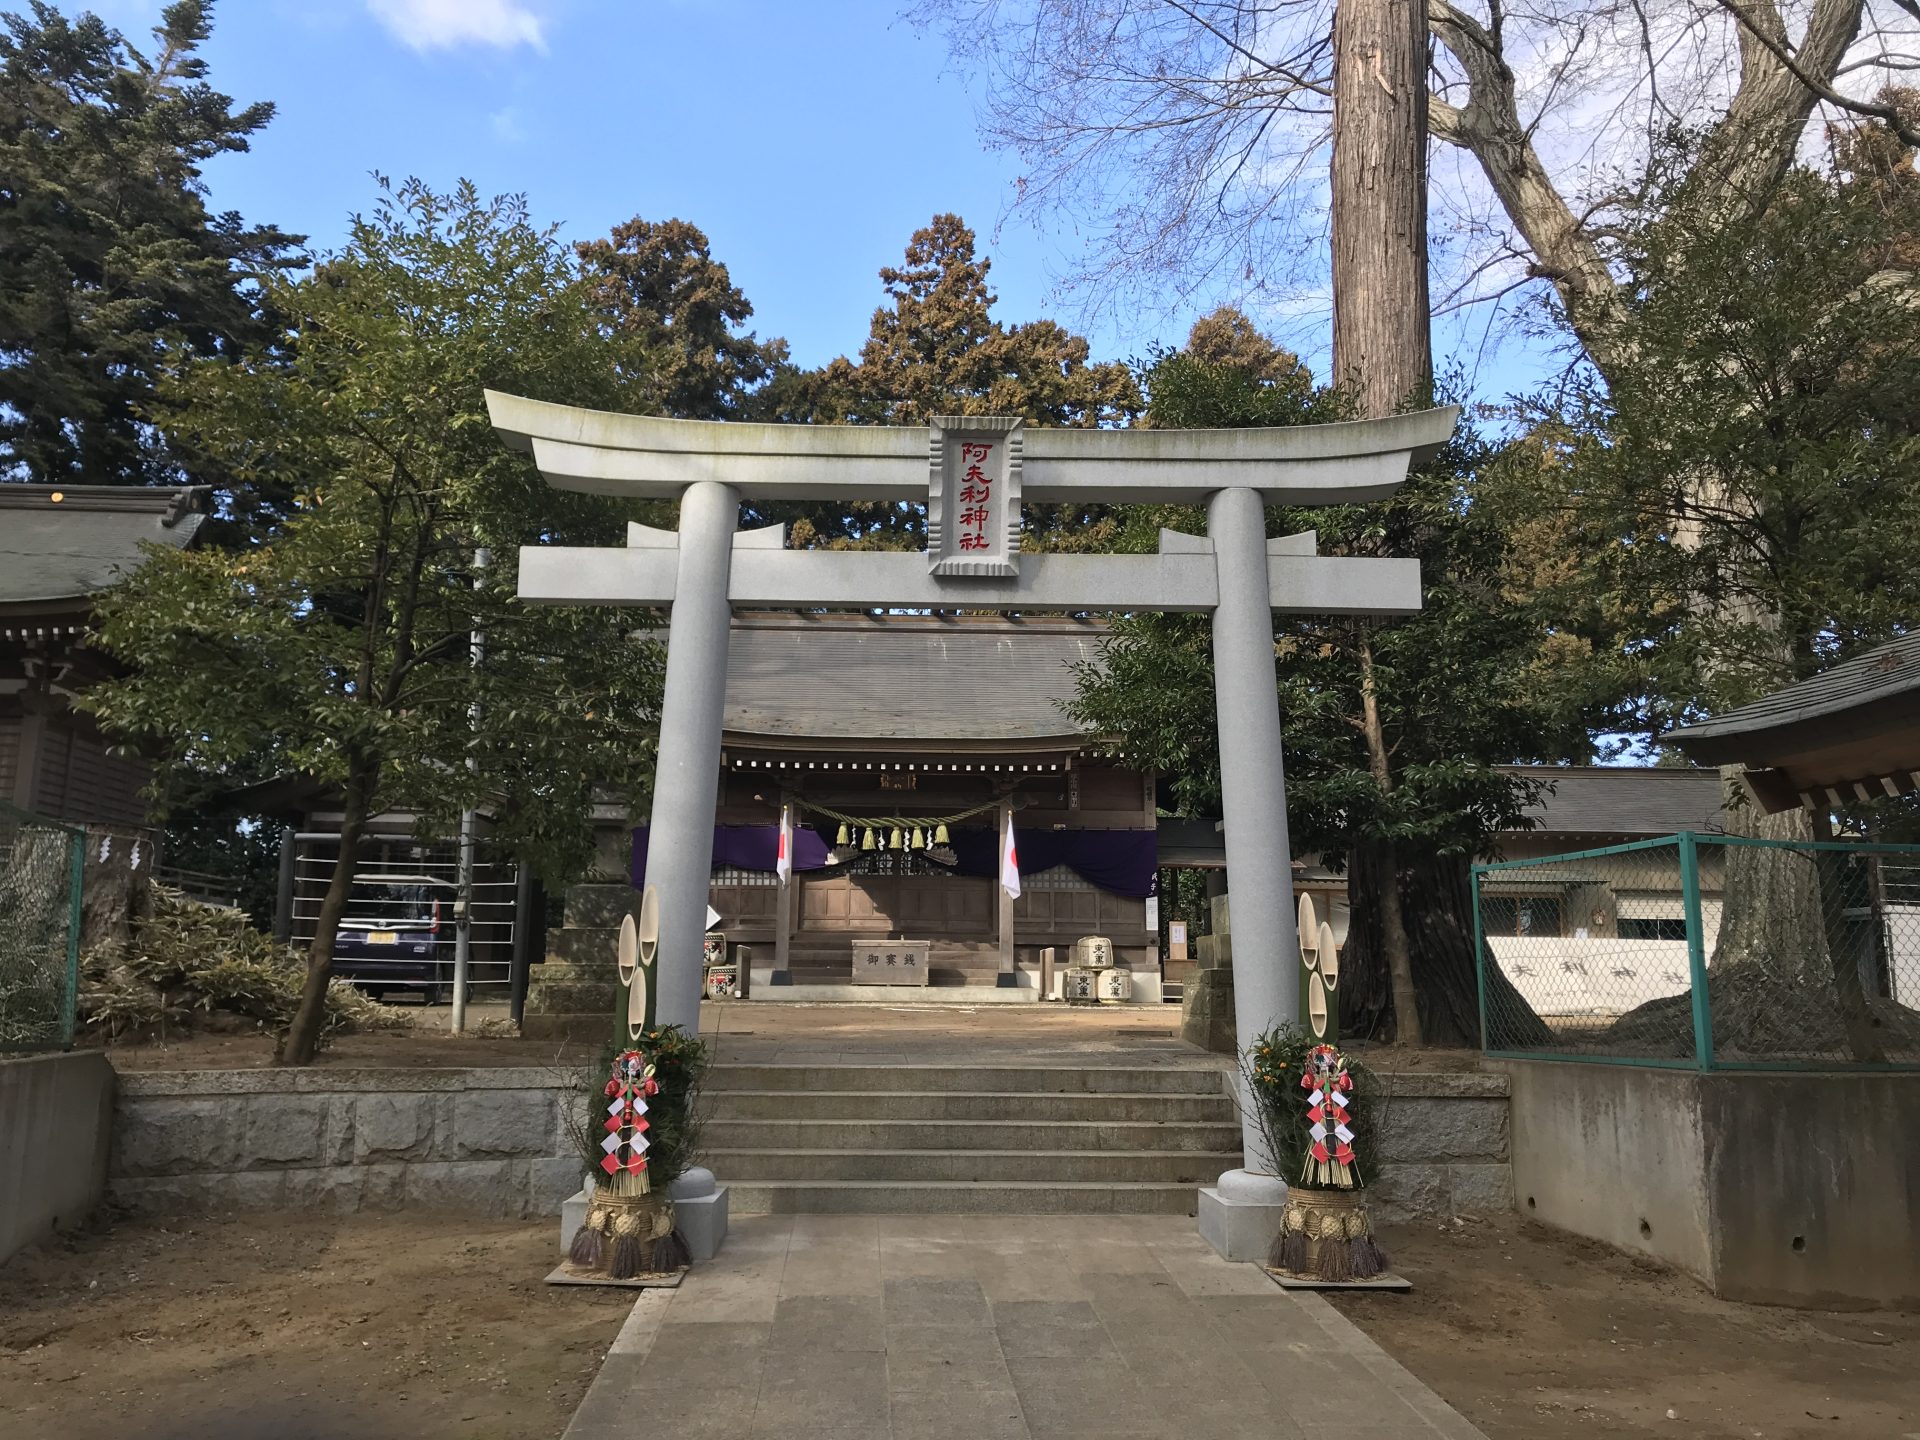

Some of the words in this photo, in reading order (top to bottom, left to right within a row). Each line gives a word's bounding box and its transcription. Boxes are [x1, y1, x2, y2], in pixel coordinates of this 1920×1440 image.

[959, 442, 993, 551] 阿夫利神社
